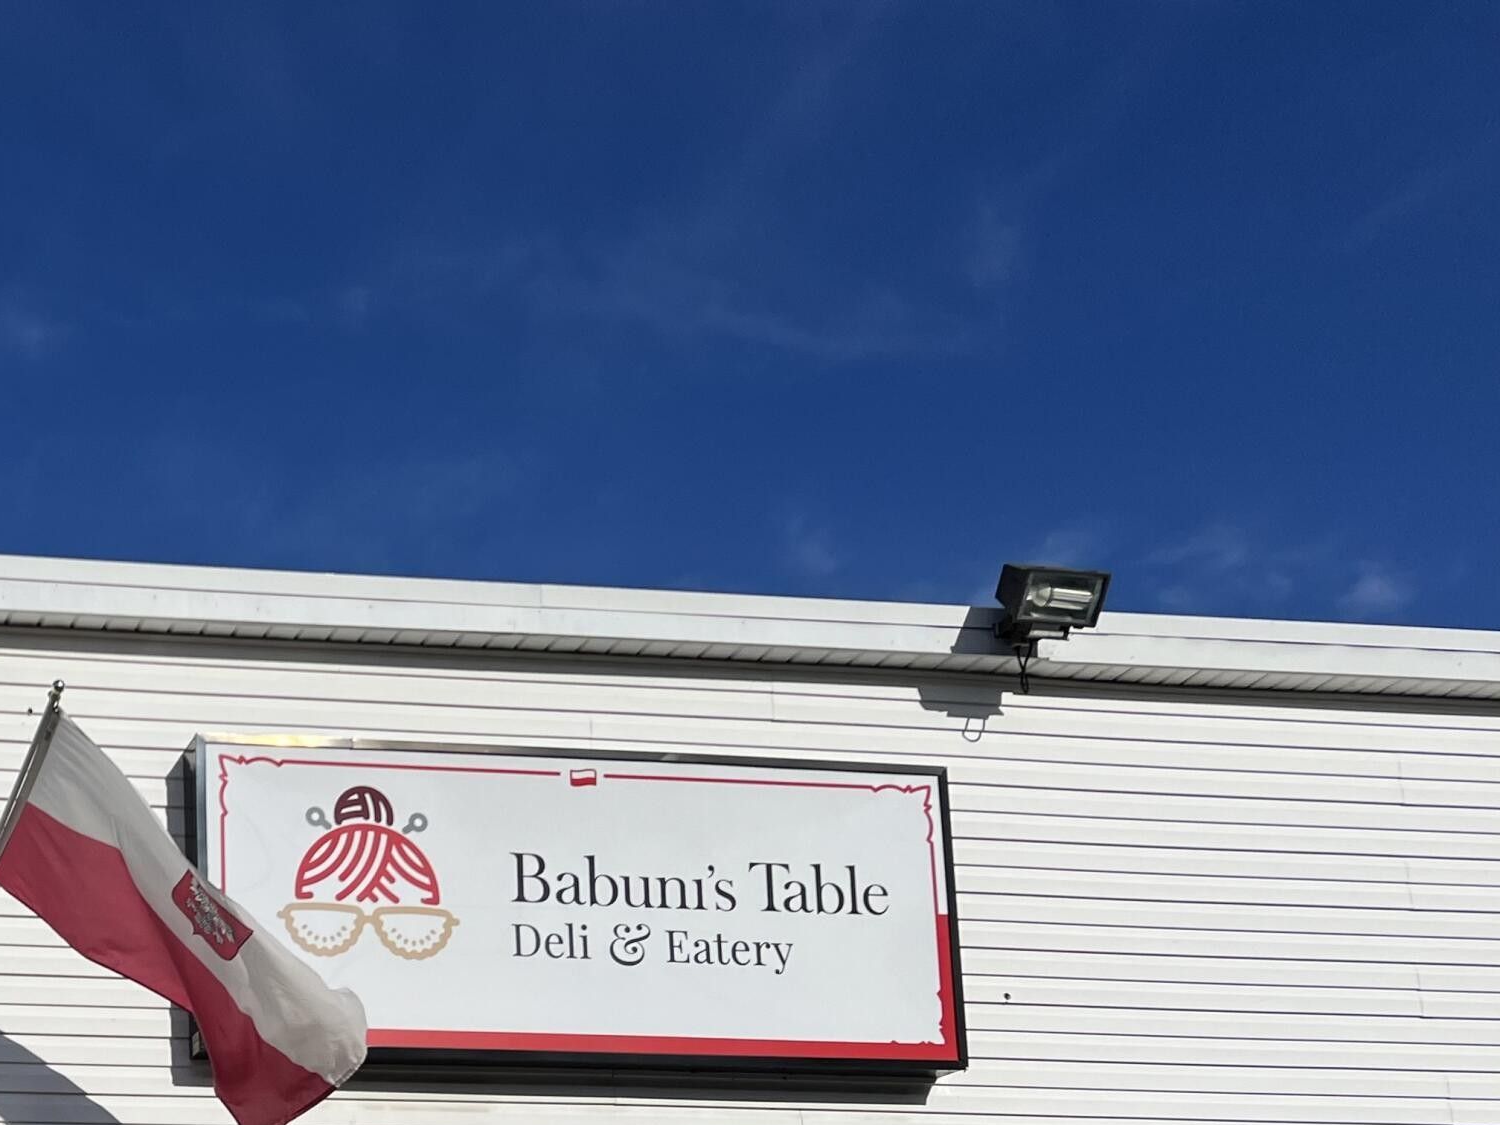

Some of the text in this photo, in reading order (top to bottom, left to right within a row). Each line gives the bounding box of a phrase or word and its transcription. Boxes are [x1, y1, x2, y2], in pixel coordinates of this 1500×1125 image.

[510, 852, 890, 915] Babuni's Table
[512, 922, 793, 975] Deli & Eatery
